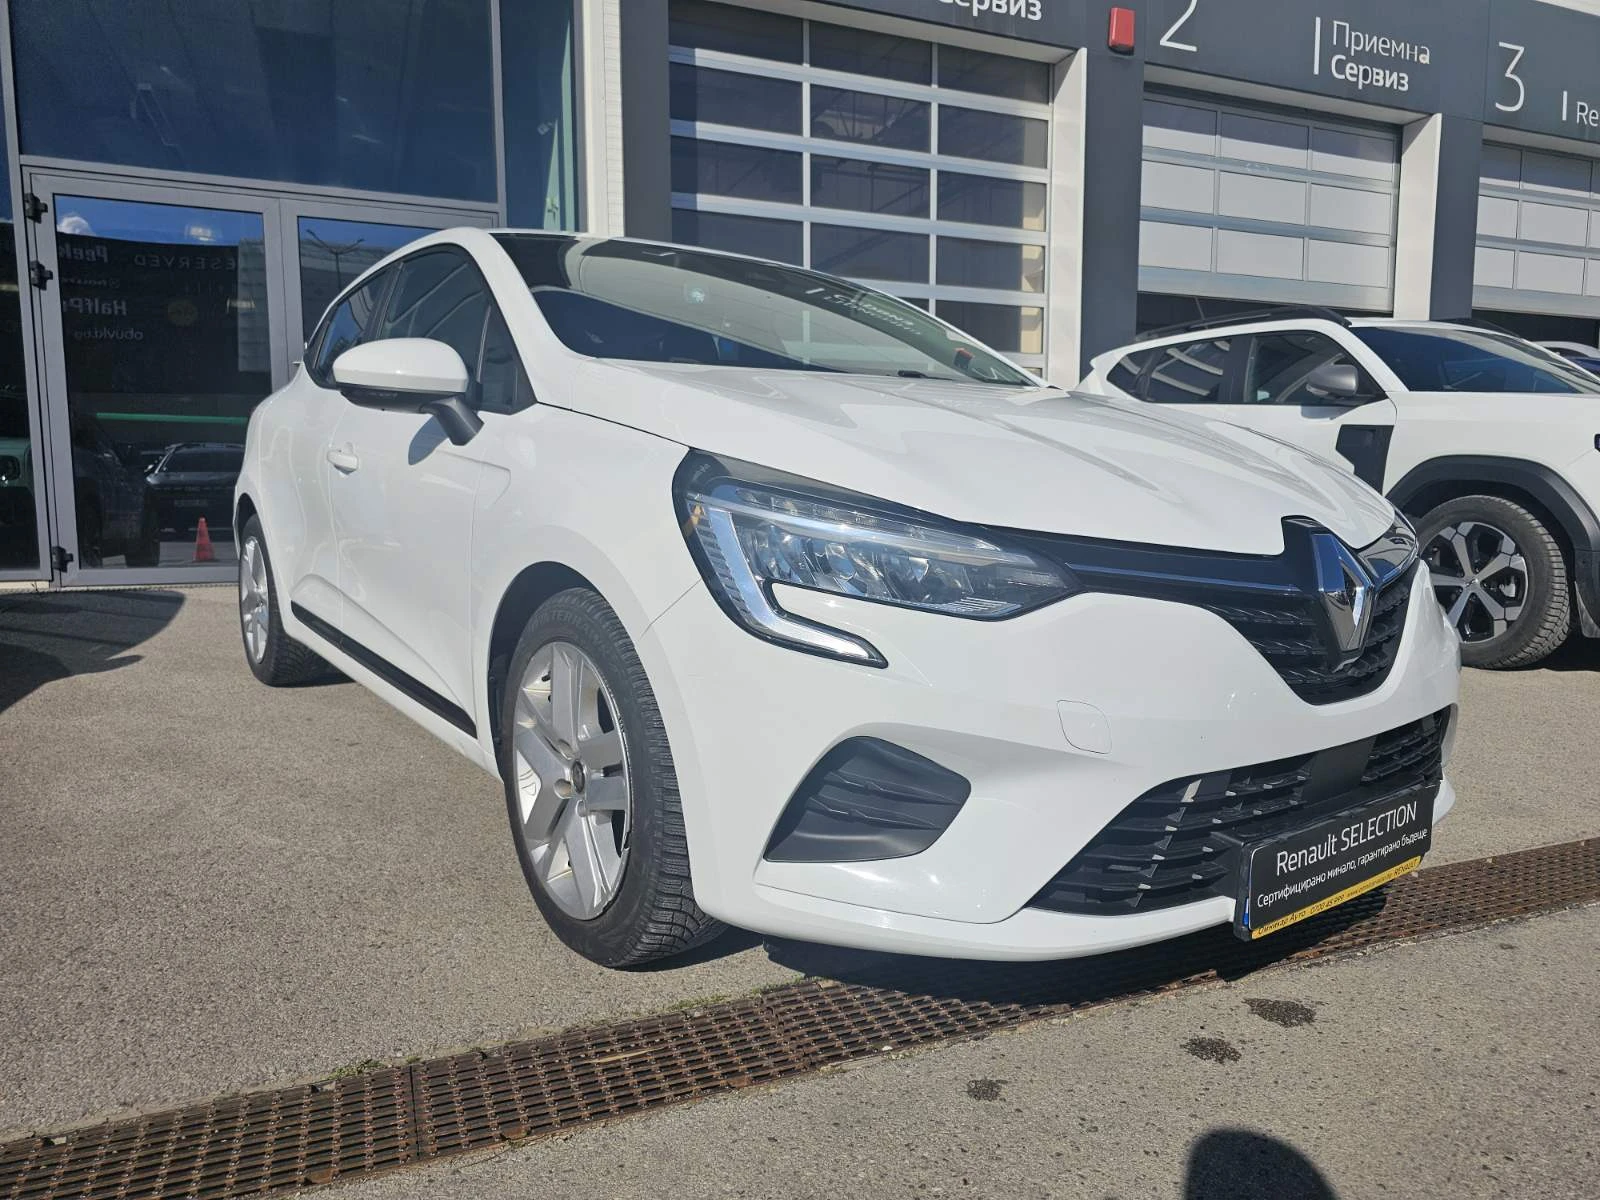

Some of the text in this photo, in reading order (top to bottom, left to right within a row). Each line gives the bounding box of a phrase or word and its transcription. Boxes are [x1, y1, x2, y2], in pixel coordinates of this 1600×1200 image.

[938, 0, 1043, 21] рвиз
[1159, 0, 1198, 52] 2
[1332, 20, 1430, 65] Приемна
[1331, 54, 1409, 91] Сервиз
[1495, 41, 1525, 112] 3
[1276, 800, 1417, 876] Renault SELECTION
[1257, 872, 1327, 908] Сертифицирано
[1357, 840, 1401, 867] гарантирано
[1401, 828, 1428, 847] бъдеще
